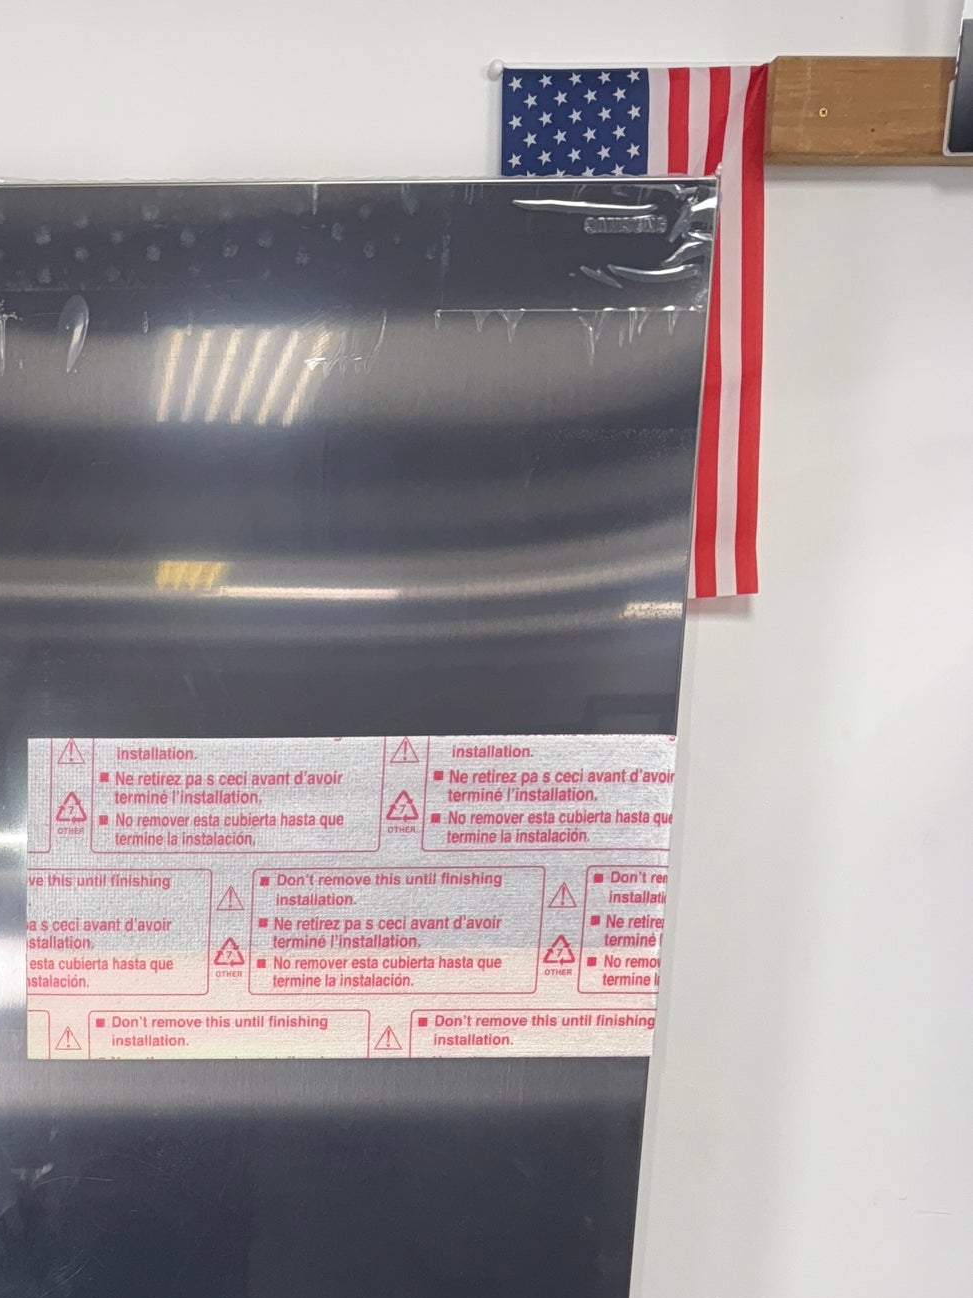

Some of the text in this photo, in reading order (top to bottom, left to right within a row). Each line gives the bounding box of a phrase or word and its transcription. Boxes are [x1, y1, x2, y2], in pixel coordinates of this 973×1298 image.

[116, 747, 197, 760] installation.
[114, 771, 343, 789] Ne retirez pa s ceci avant d'avoir
[115, 813, 344, 829] No remover esta cubierta hasta que
[57, 827, 85, 835] OTHER
[115, 833, 256, 846] termine la instalación.
[276, 871, 503, 887] Don't remove this until finishing
[276, 894, 357, 906] installation.
[273, 916, 502, 933] Ne retirez pa s ceci avant d'avoir
[273, 956, 502, 971] No remover esta cubierta hasta que
[272, 974, 414, 987] termine la instalación.
